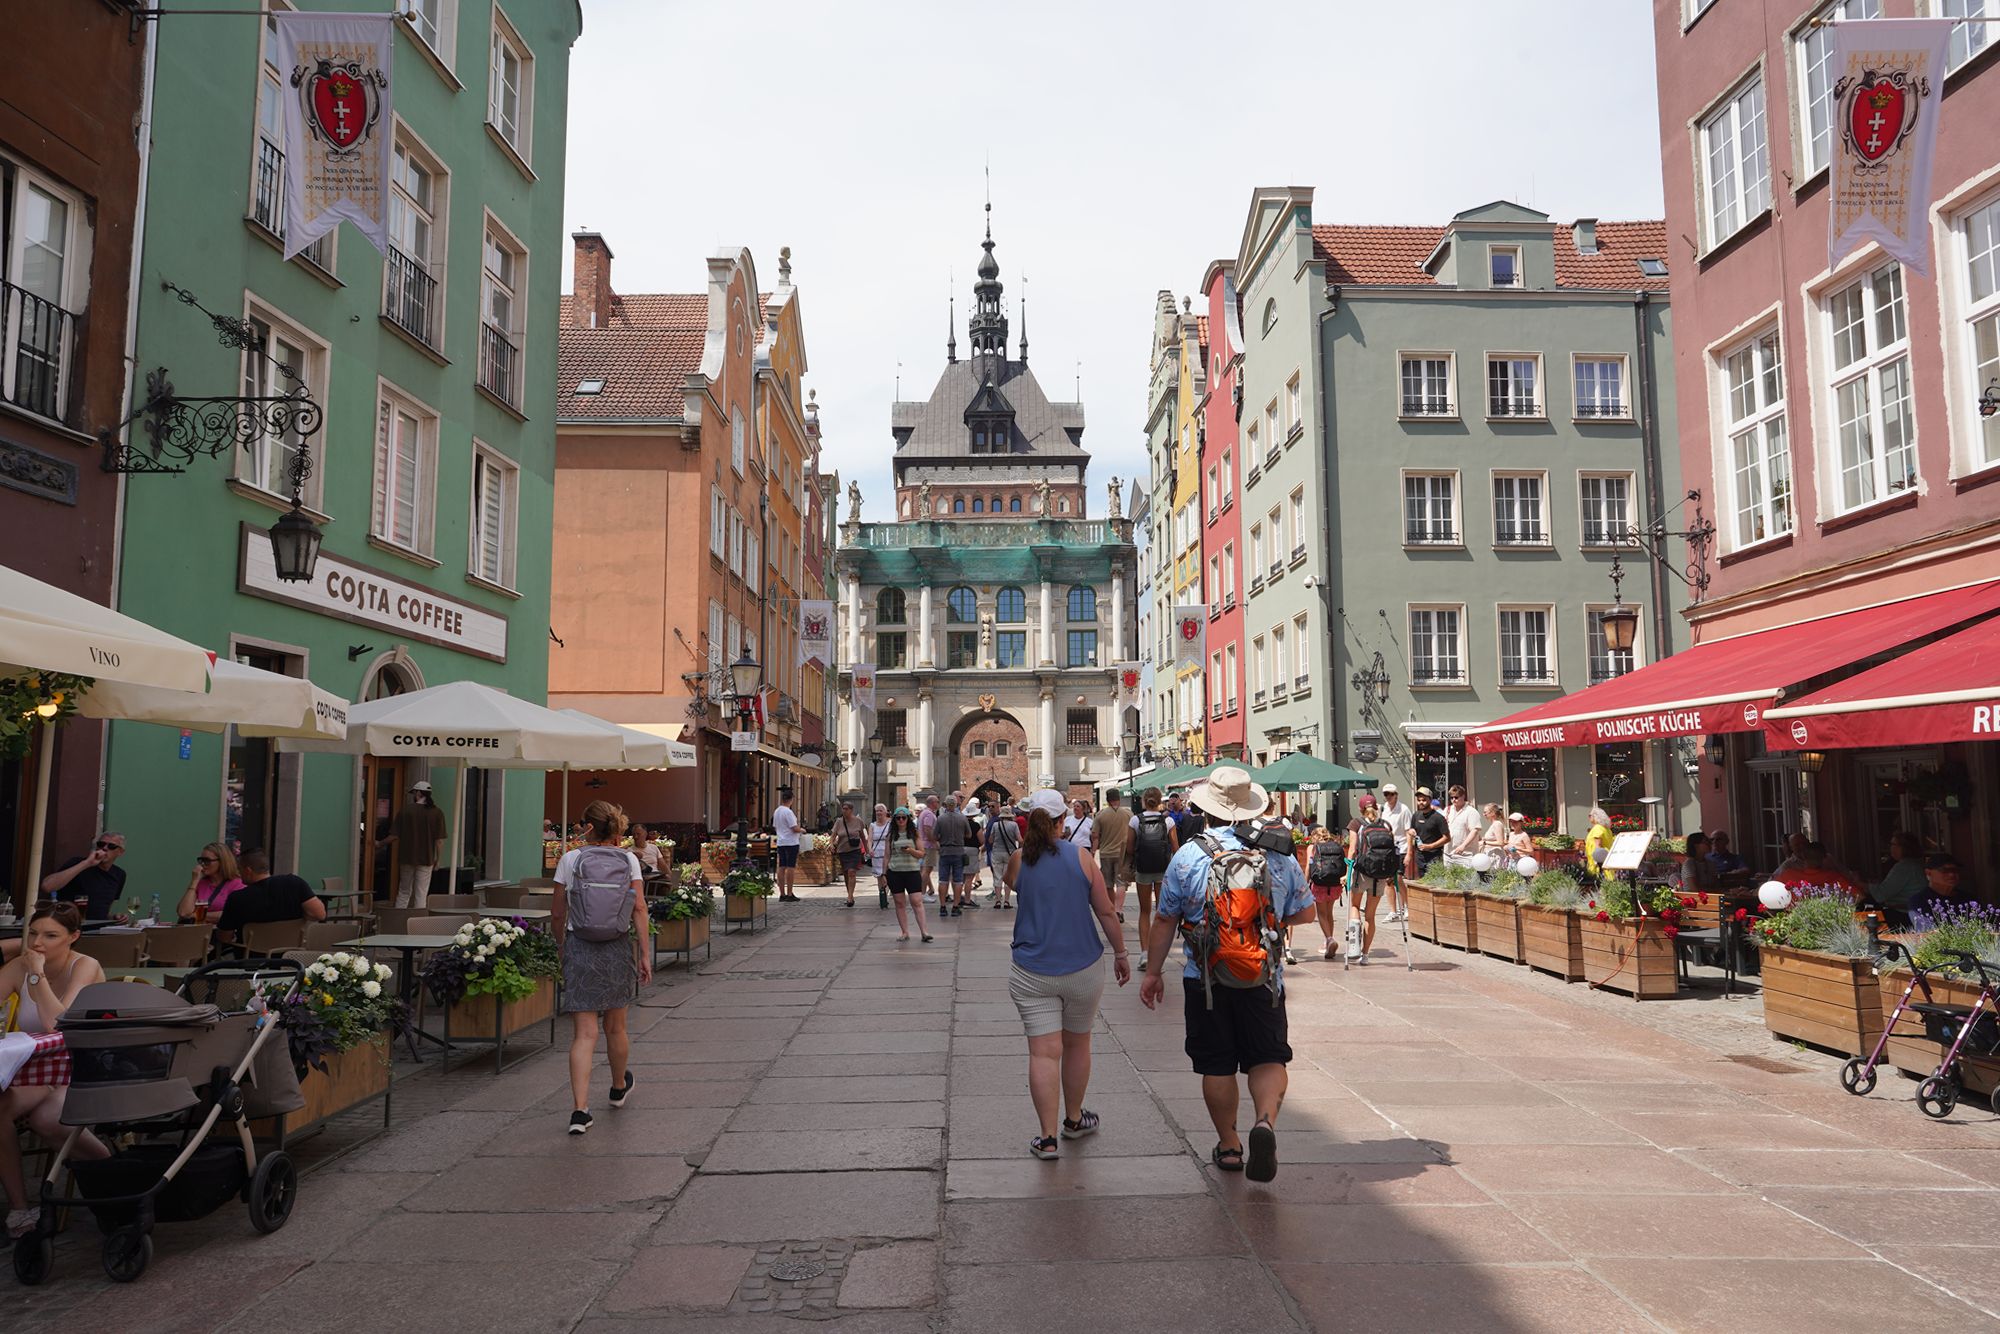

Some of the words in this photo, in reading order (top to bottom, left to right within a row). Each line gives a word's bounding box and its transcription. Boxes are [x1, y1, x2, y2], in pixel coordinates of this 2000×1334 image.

[326, 570, 390, 614] COSTA
[397, 594, 463, 636] COFFEE
[89, 646, 121, 668] VINO
[1596, 716, 1656, 738] POLNISCHE
[1659, 710, 1702, 730] KÜCHE
[393, 735, 441, 747] COSTA
[446, 736, 499, 748] COFFEE
[1502, 731, 1530, 747] POLISH
[1530, 727, 1565, 744] CUISINE
